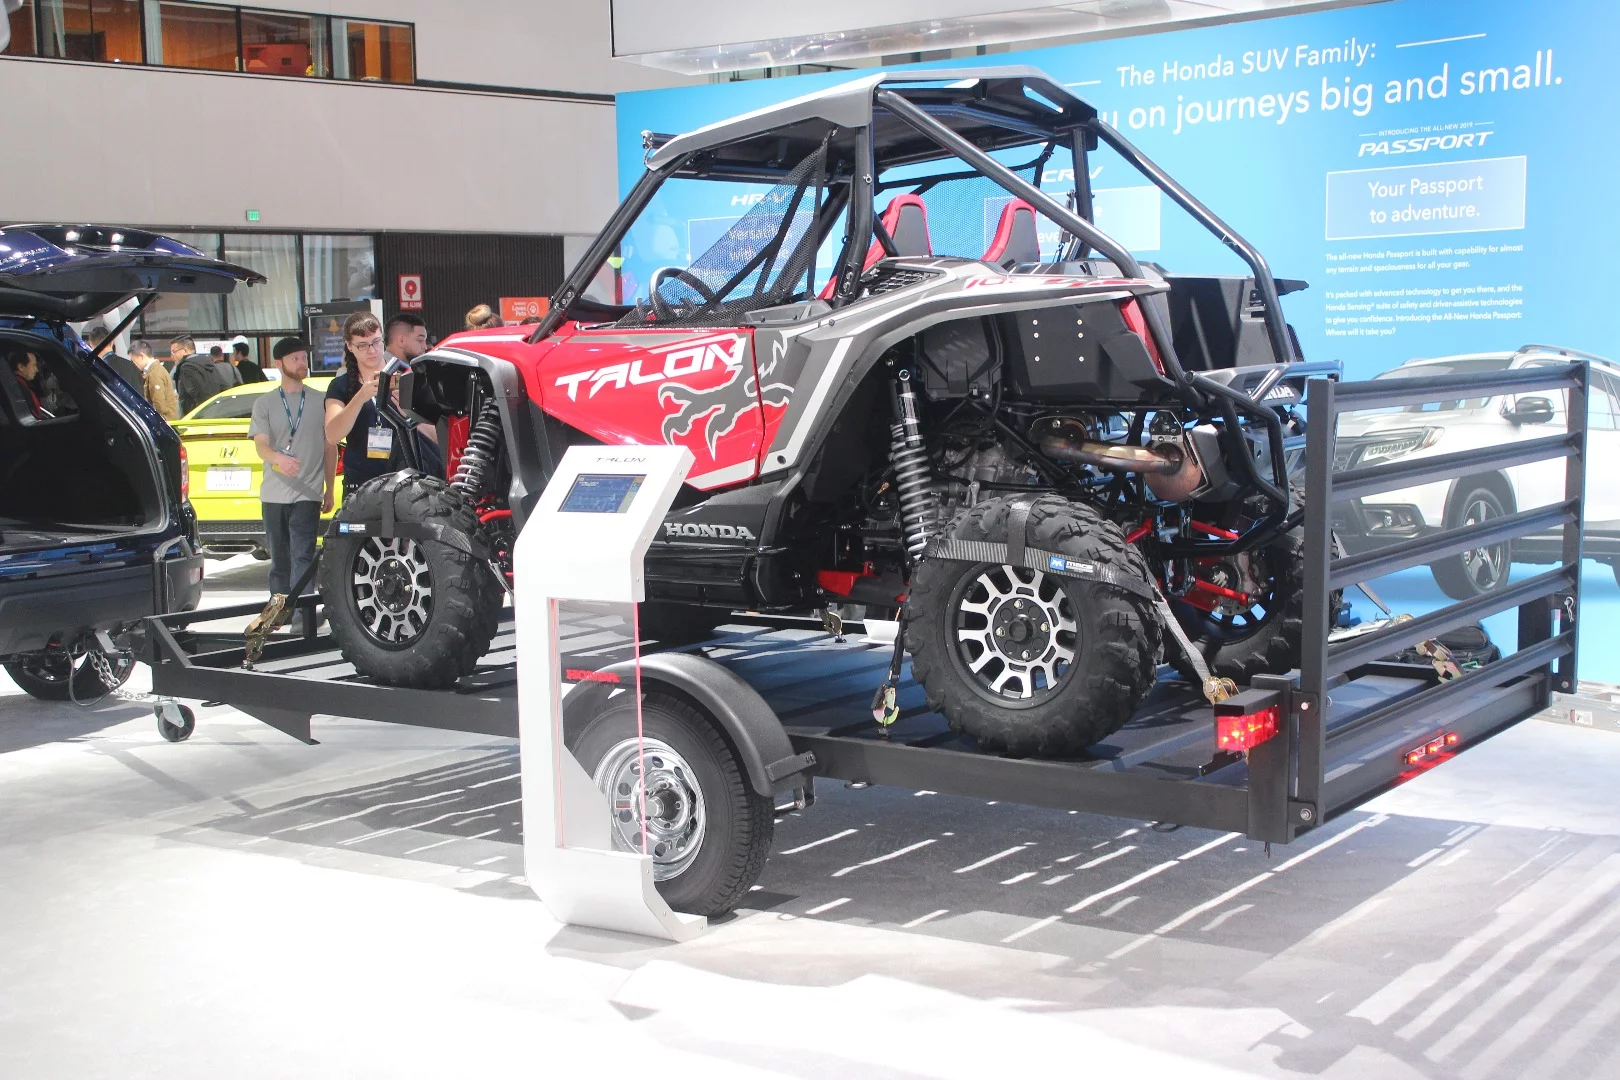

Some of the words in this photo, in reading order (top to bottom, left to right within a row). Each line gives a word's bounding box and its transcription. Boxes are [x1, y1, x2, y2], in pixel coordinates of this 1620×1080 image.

[1116, 64, 1155, 87] The
[1162, 54, 1234, 83] Honda
[1241, 48, 1289, 74] SUV
[1295, 37, 1376, 67] Family:
[1128, 105, 1166, 130] on
[1173, 89, 1310, 135] journeys
[1320, 76, 1373, 117] big
[1384, 62, 1449, 104] and
[1459, 48, 1562, 96] small.
[1378, 127, 1418, 136] INTRODUCING
[1432, 123, 1458, 132] ALL-NEW
[1358, 131, 1494, 157] PASSPORT
[1368, 181, 1406, 199] Your
[1410, 175, 1484, 197] Passport
[1369, 208, 1386, 224] to
[1392, 204, 1480, 222] adventure.
[1326, 253, 1337, 261] The
[1339, 252, 1362, 260] all-new
[1363, 251, 1384, 259] Honda
[1386, 250, 1414, 259] Passport
[1422, 248, 1437, 256] built
[1438, 247, 1453, 255] with
[1454, 245, 1487, 256] capability
[1500, 244, 1523, 252] almost
[1326, 266, 1337, 274] any
[1338, 265, 1358, 273] terrain
[1360, 264, 1372, 272] and
[1374, 262, 1416, 273] spaciousness
[1427, 261, 1435, 269] all
[1437, 262, 1452, 270] your
[1453, 261, 1470, 269] gear.
[1335, 290, 1357, 299] packed
[1359, 289, 1372, 297] with
[1374, 289, 1404, 297] advanced
[1405, 288, 1441, 297] technology
[1442, 287, 1449, 295] to
[1451, 286, 1462, 296] get
[1463, 287, 1475, 295] you
[1497, 284, 1510, 292] and
[1511, 284, 1522, 292] the
[1326, 303, 1346, 311] Honda
[1376, 302, 1390, 310] suite
[1392, 301, 1399, 309] of
[1400, 300, 1418, 310] safety
[1419, 300, 1431, 308] and
[1480, 298, 1522, 307] technologies
[1333, 316, 1346, 325] give
[1347, 316, 1358, 324] you
[1359, 314, 1394, 323] confidence.
[1396, 313, 1430, 324] Introducing
[1432, 313, 1442, 321] the
[1443, 312, 1468, 321] All-New
[1470, 312, 1491, 320] Honda
[1348, 328, 1358, 336] will
[1366, 327, 1378, 335] take
[1380, 327, 1396, 337] you?
[555, 337, 746, 402] TALON
[664, 522, 756, 540] HONDA
